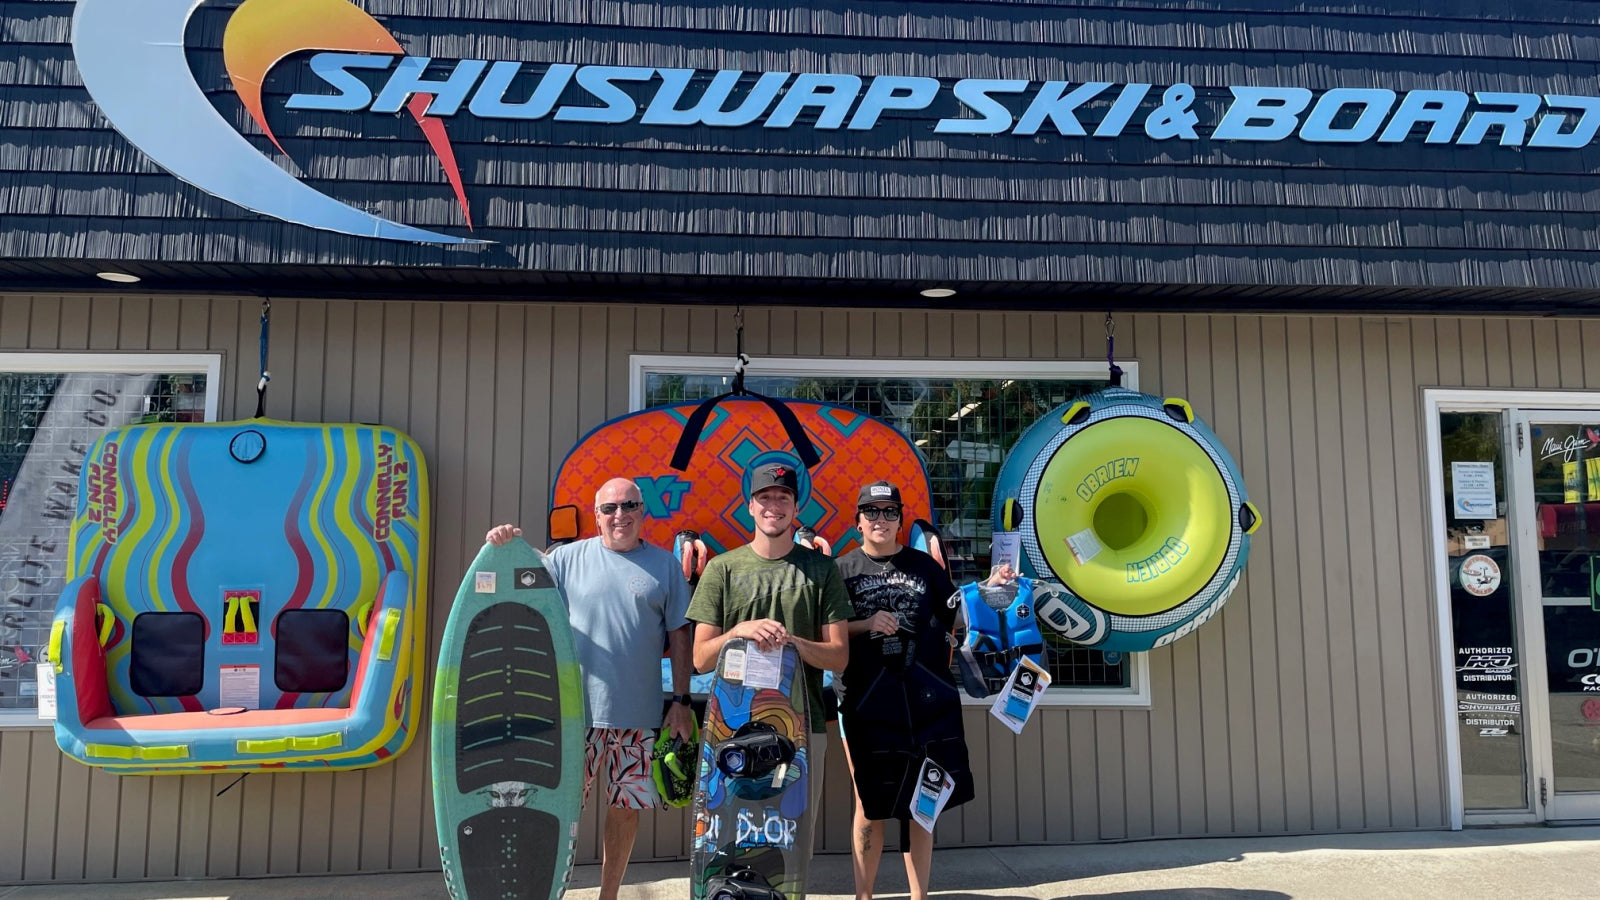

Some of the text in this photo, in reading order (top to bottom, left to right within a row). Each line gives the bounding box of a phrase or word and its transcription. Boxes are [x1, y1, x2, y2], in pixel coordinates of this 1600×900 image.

[284, 52, 1600, 148] SHUSWAP SKI & BOARD
[87, 461, 103, 505] FUN
[102, 440, 120, 544] CONNELLY
[374, 443, 393, 542] CONNELLY
[391, 479, 408, 520] FUN
[1076, 457, 1140, 503] OBRIEN
[1126, 536, 1190, 583] OBRIEN
[1459, 647, 1513, 655] AUTHORIZED
[1463, 674, 1512, 682] DISTRIBUTOR
[1465, 693, 1517, 701] AUTHORIZED
[1465, 718, 1515, 726] DISTRIBUTOR
